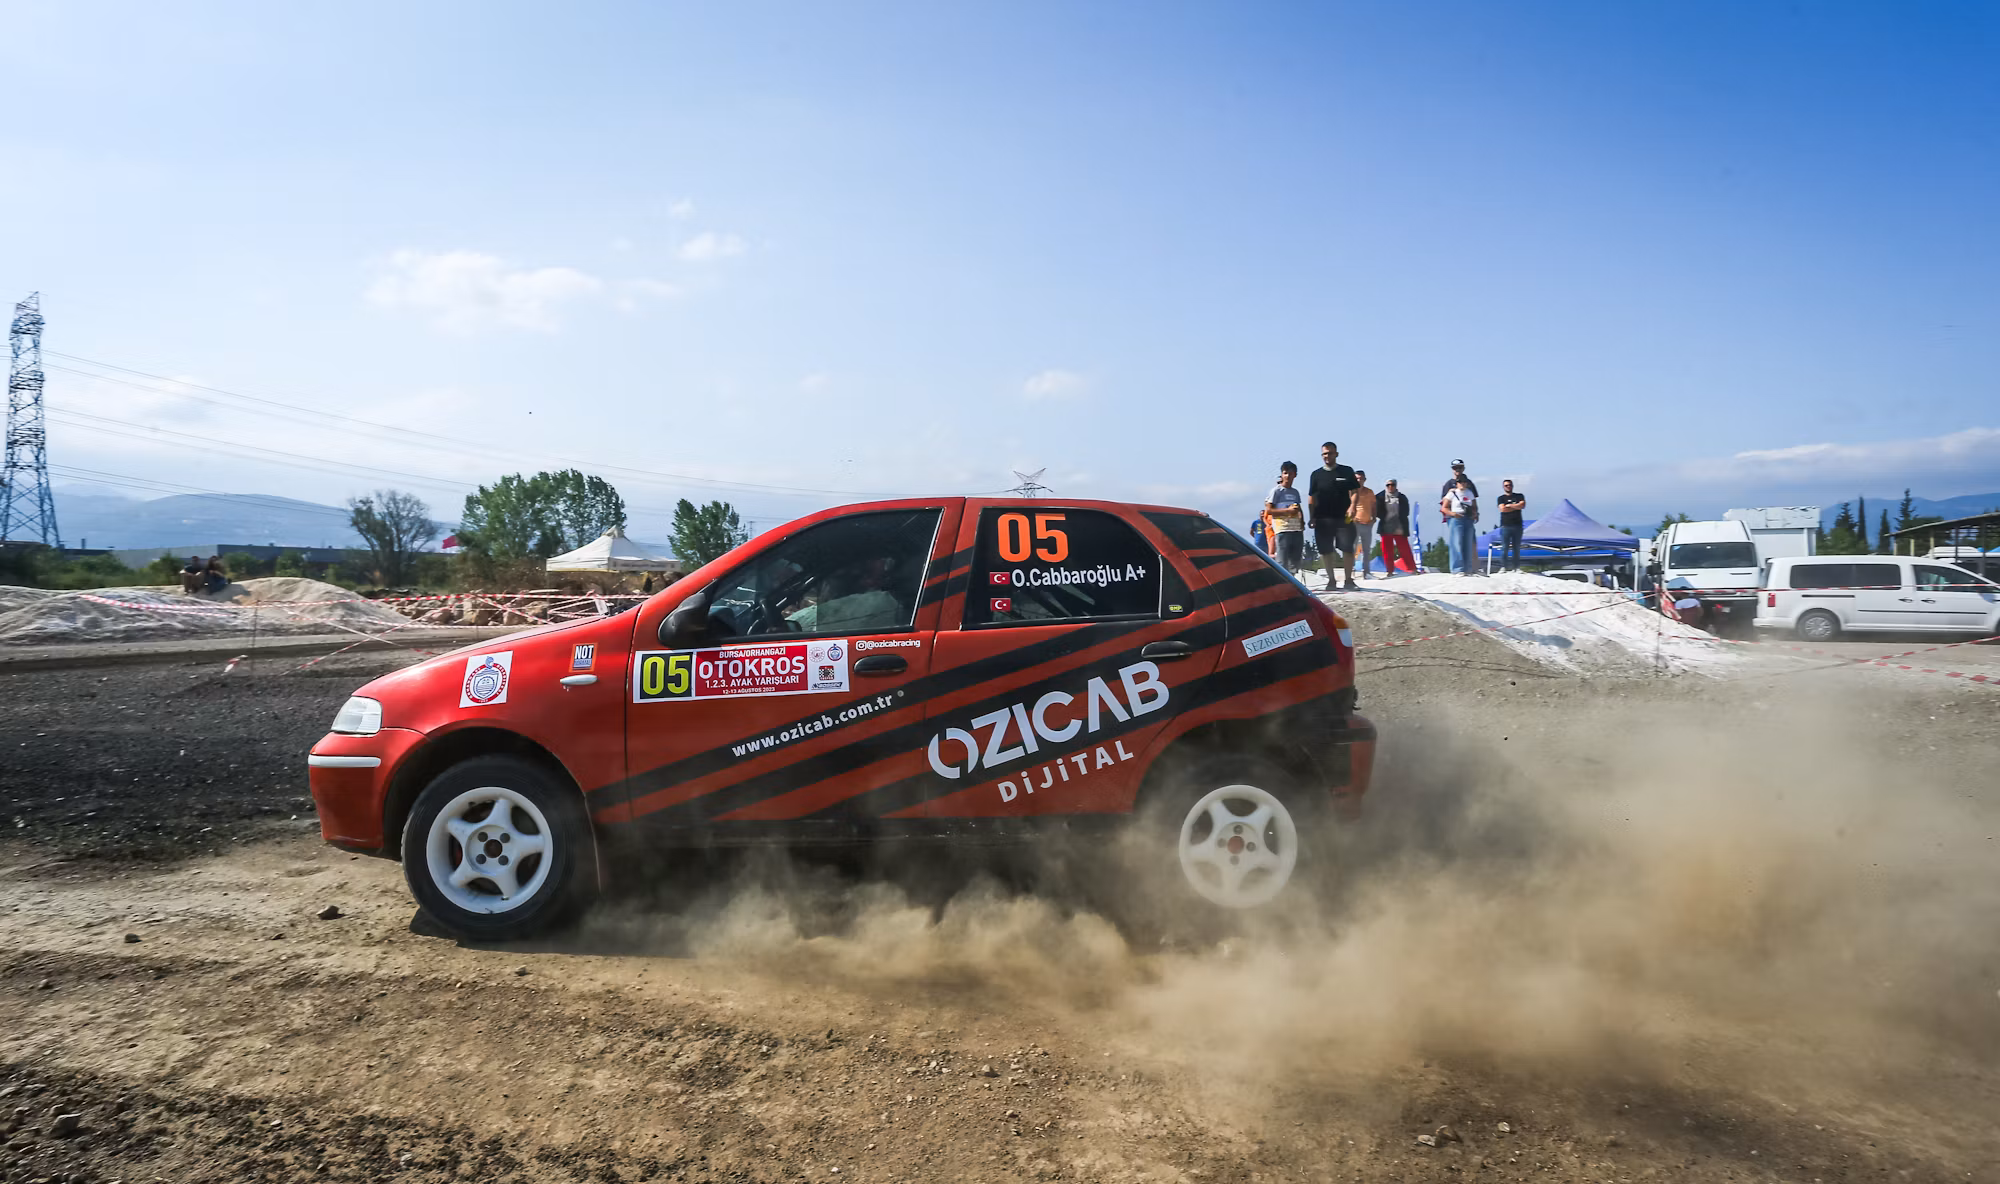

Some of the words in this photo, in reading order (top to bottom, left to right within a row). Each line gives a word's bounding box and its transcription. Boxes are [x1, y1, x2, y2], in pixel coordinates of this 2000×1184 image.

[998, 512, 1069, 563] 05
[1012, 564, 1121, 587] O.Cabbaroğlu
[1125, 563, 1146, 582] A+
[867, 639, 920, 650] @ozicabracing
[1245, 625, 1310, 654] SEZBURGER
[574, 645, 595, 659] NOT
[719, 646, 786, 659] BURSA/ORHANGAZİ
[643, 655, 690, 695] 05
[698, 656, 806, 679] OTOKROS
[705, 679, 728, 689] 1.2.3.
[730, 677, 753, 687] AYAK
[755, 675, 799, 686] YARIŞLARI
[731, 694, 893, 757] www.ozicab.com.tr
[928, 660, 1170, 779] OZICAB
